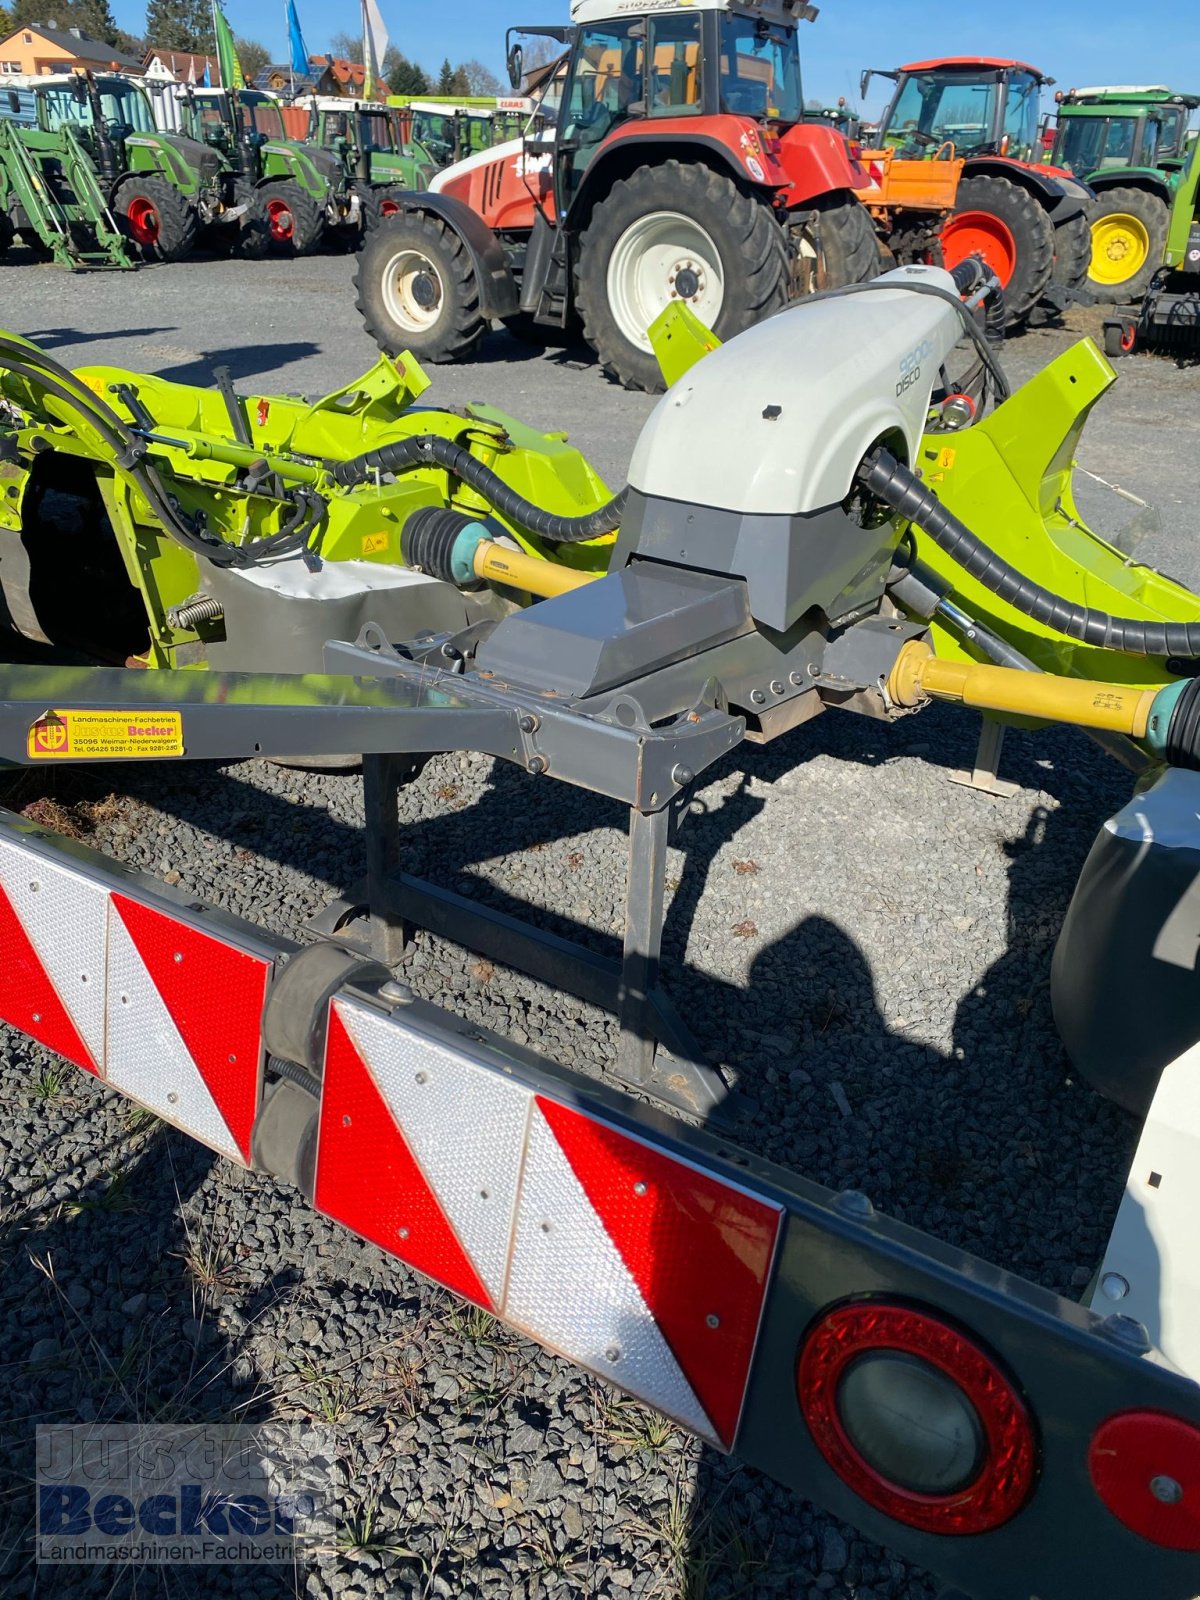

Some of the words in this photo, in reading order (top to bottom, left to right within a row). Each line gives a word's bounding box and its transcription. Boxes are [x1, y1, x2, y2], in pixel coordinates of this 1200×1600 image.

[895, 366, 921, 398] DISCO
[72, 716, 177, 724] Landmaschinen-Fachbetrieb
[73, 724, 125, 737] Justus
[127, 725, 174, 737] Becker
